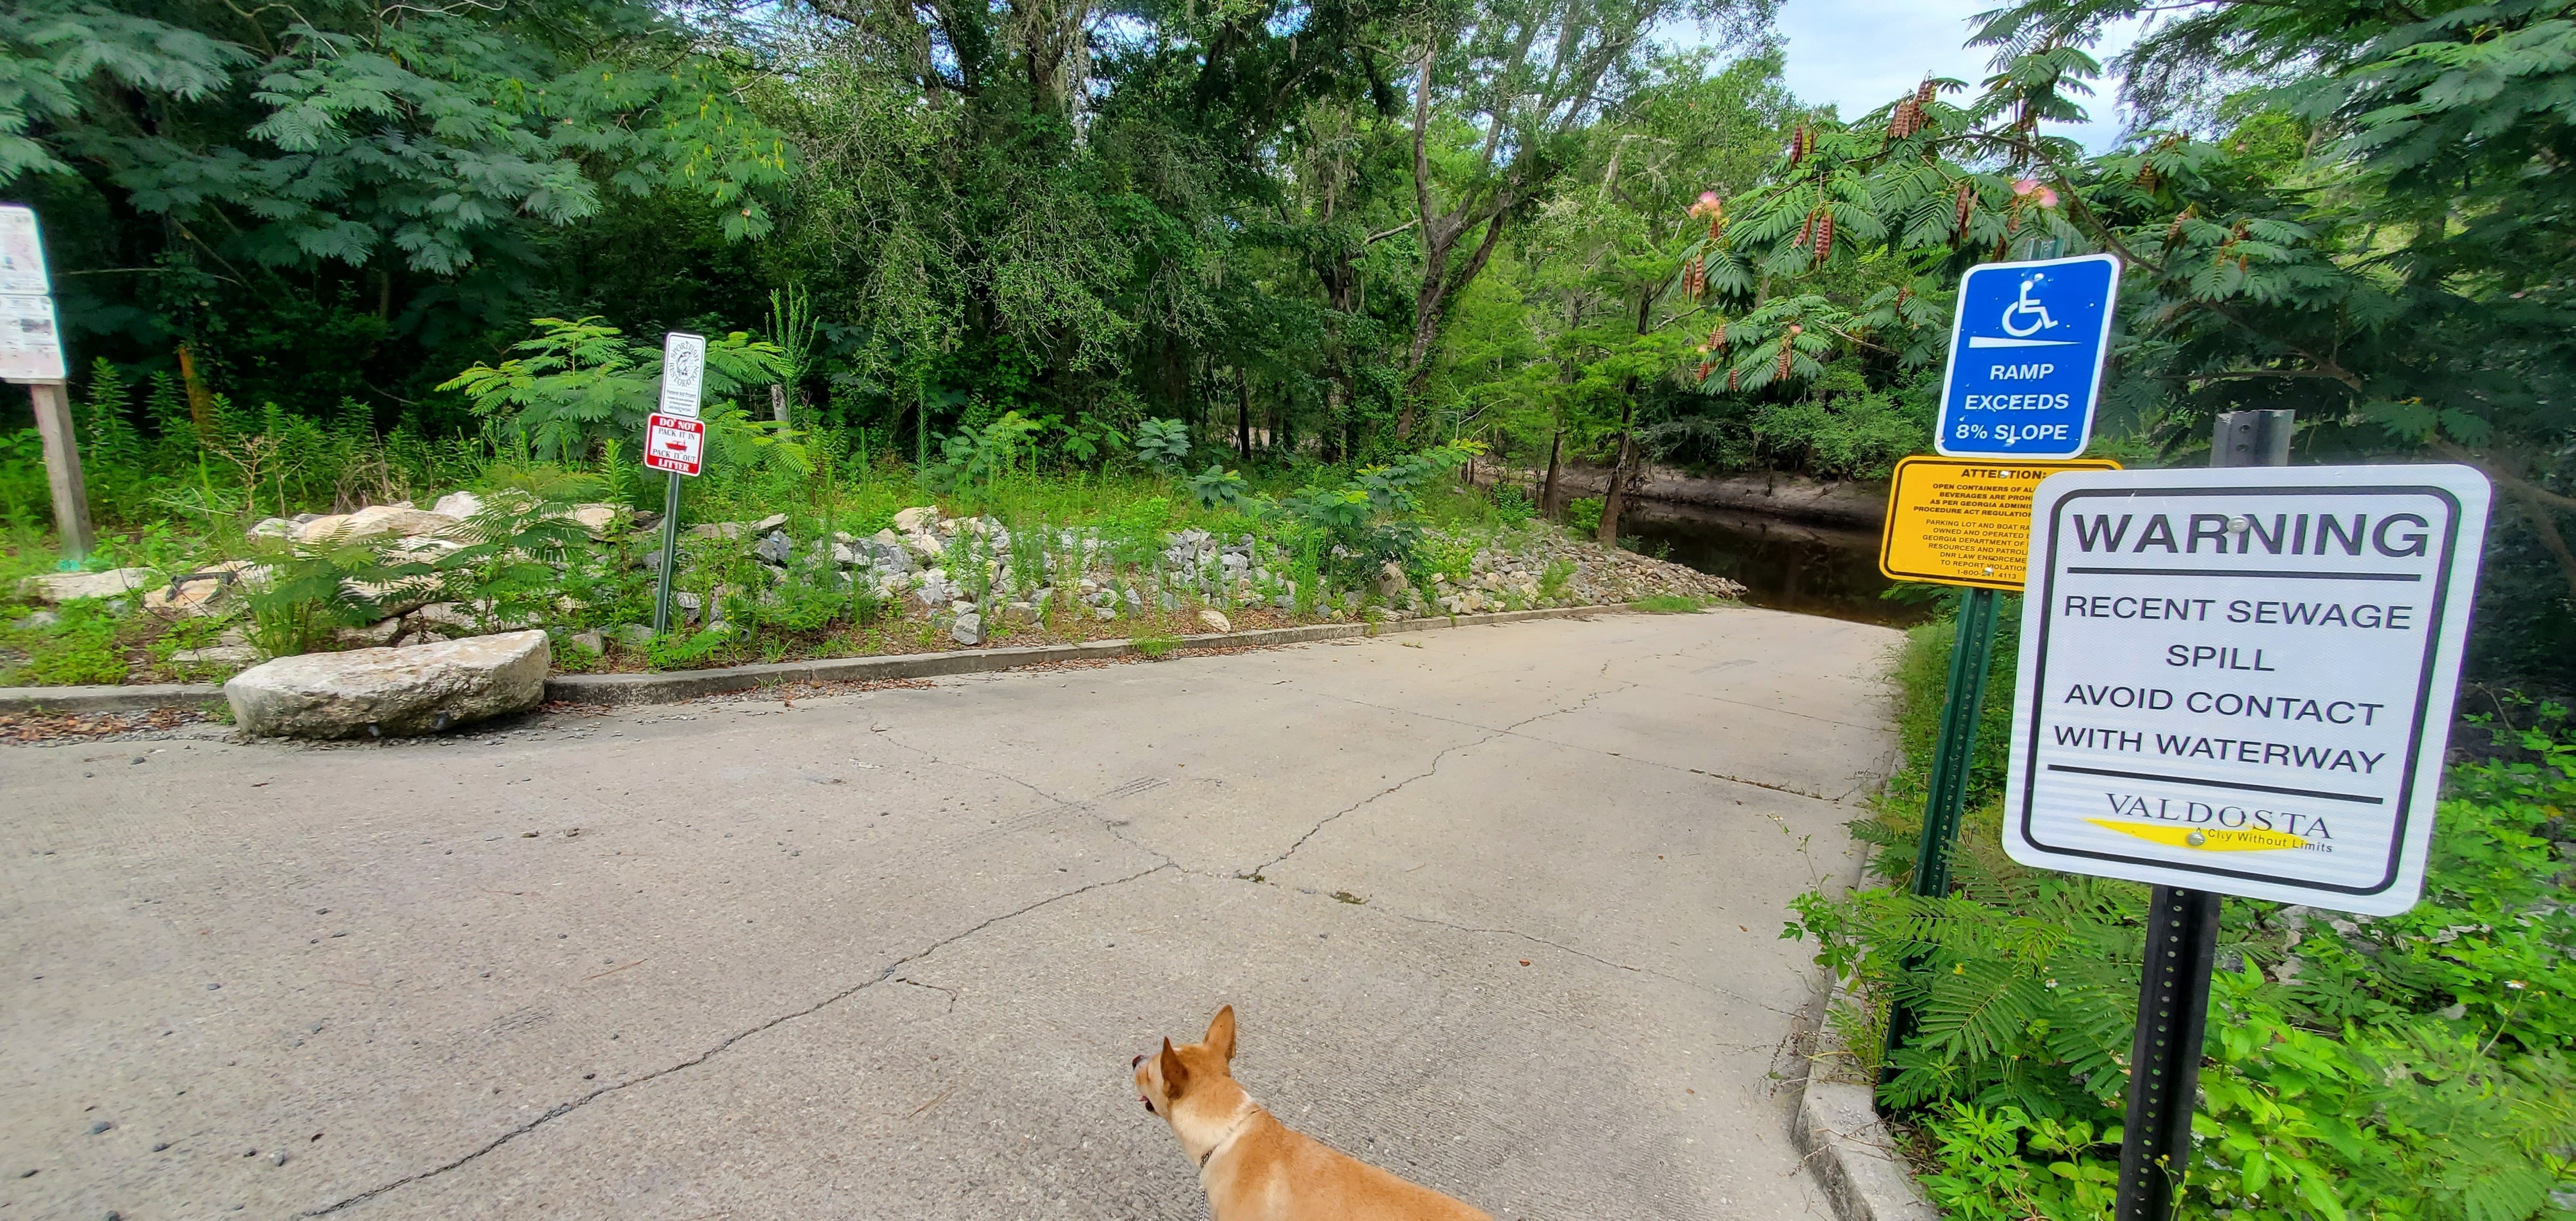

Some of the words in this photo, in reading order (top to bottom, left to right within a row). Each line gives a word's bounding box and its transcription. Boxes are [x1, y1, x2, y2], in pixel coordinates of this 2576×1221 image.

[671, 340, 699, 362] SPORTFISH
[669, 363, 699, 387] RESTORATION
[1990, 364, 2054, 381] RAMP
[1965, 394, 2070, 410] EXCEEDS
[659, 418, 675, 428] DO
[678, 420, 696, 432] NOT
[659, 428, 676, 437] PACK
[1956, 424, 1988, 439] 8%
[1993, 424, 2070, 440] SLOPE
[652, 448, 670, 458] PACK
[683, 454, 697, 463] OUT
[658, 458, 689, 472] LITTER
[1959, 537, 2012, 546] DEPARTMENT
[2072, 513, 2430, 558] WARNING
[1928, 543, 1975, 552] RESOURCES
[2064, 595, 2215, 621] RECENT
[2226, 600, 2413, 630] SEWAGE
[2166, 644, 2275, 671] SPILL
[2064, 684, 2174, 710] AVOID
[2186, 692, 2384, 726] CONTACT
[2053, 725, 2142, 753] WITH
[2156, 733, 2386, 774] WATERWAY
[2105, 793, 2334, 839] VALDOSTA
[2237, 832, 2287, 847] Without
[2292, 839, 2333, 853] Limits
